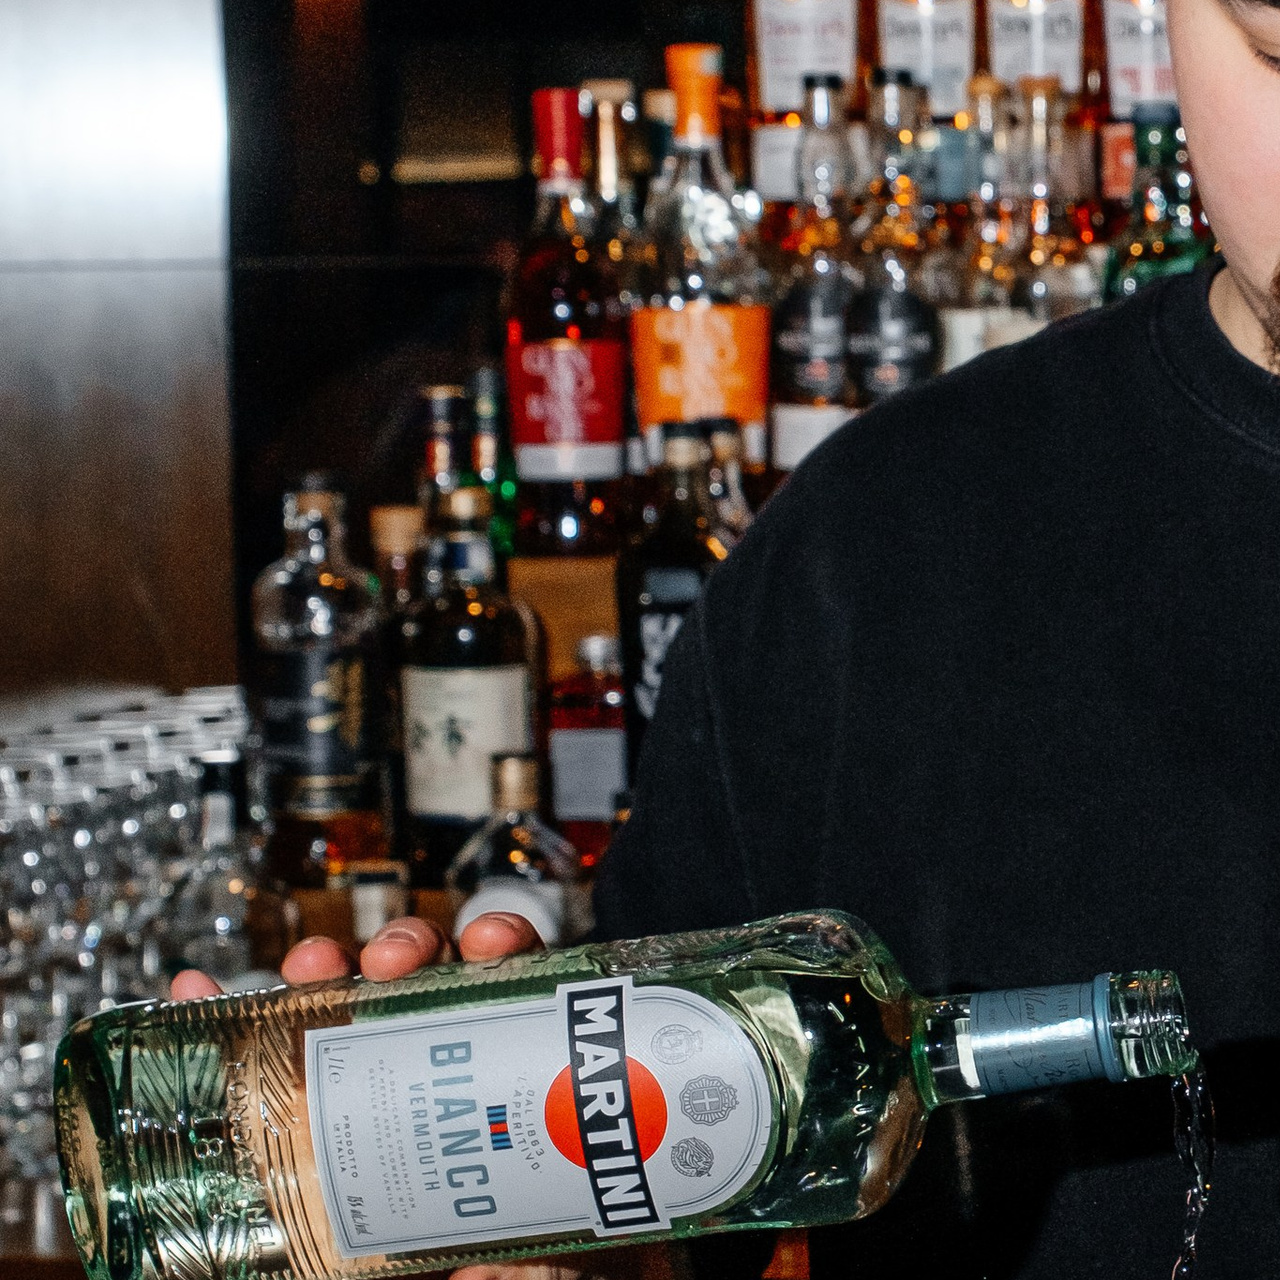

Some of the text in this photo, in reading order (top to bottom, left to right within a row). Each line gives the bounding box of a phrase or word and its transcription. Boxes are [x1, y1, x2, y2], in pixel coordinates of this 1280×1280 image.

[408, 1081, 441, 1191] VERMOUTH
[429, 1040, 498, 1218] BIANCO
[525, 1089, 545, 1157] DAL 1863
[573, 995, 652, 1222] MARTINI
[334, 1135, 347, 1173] ITALIA
[342, 1114, 358, 1179] PRODOTTO
[397, 1139, 416, 1209] COMBINATION
